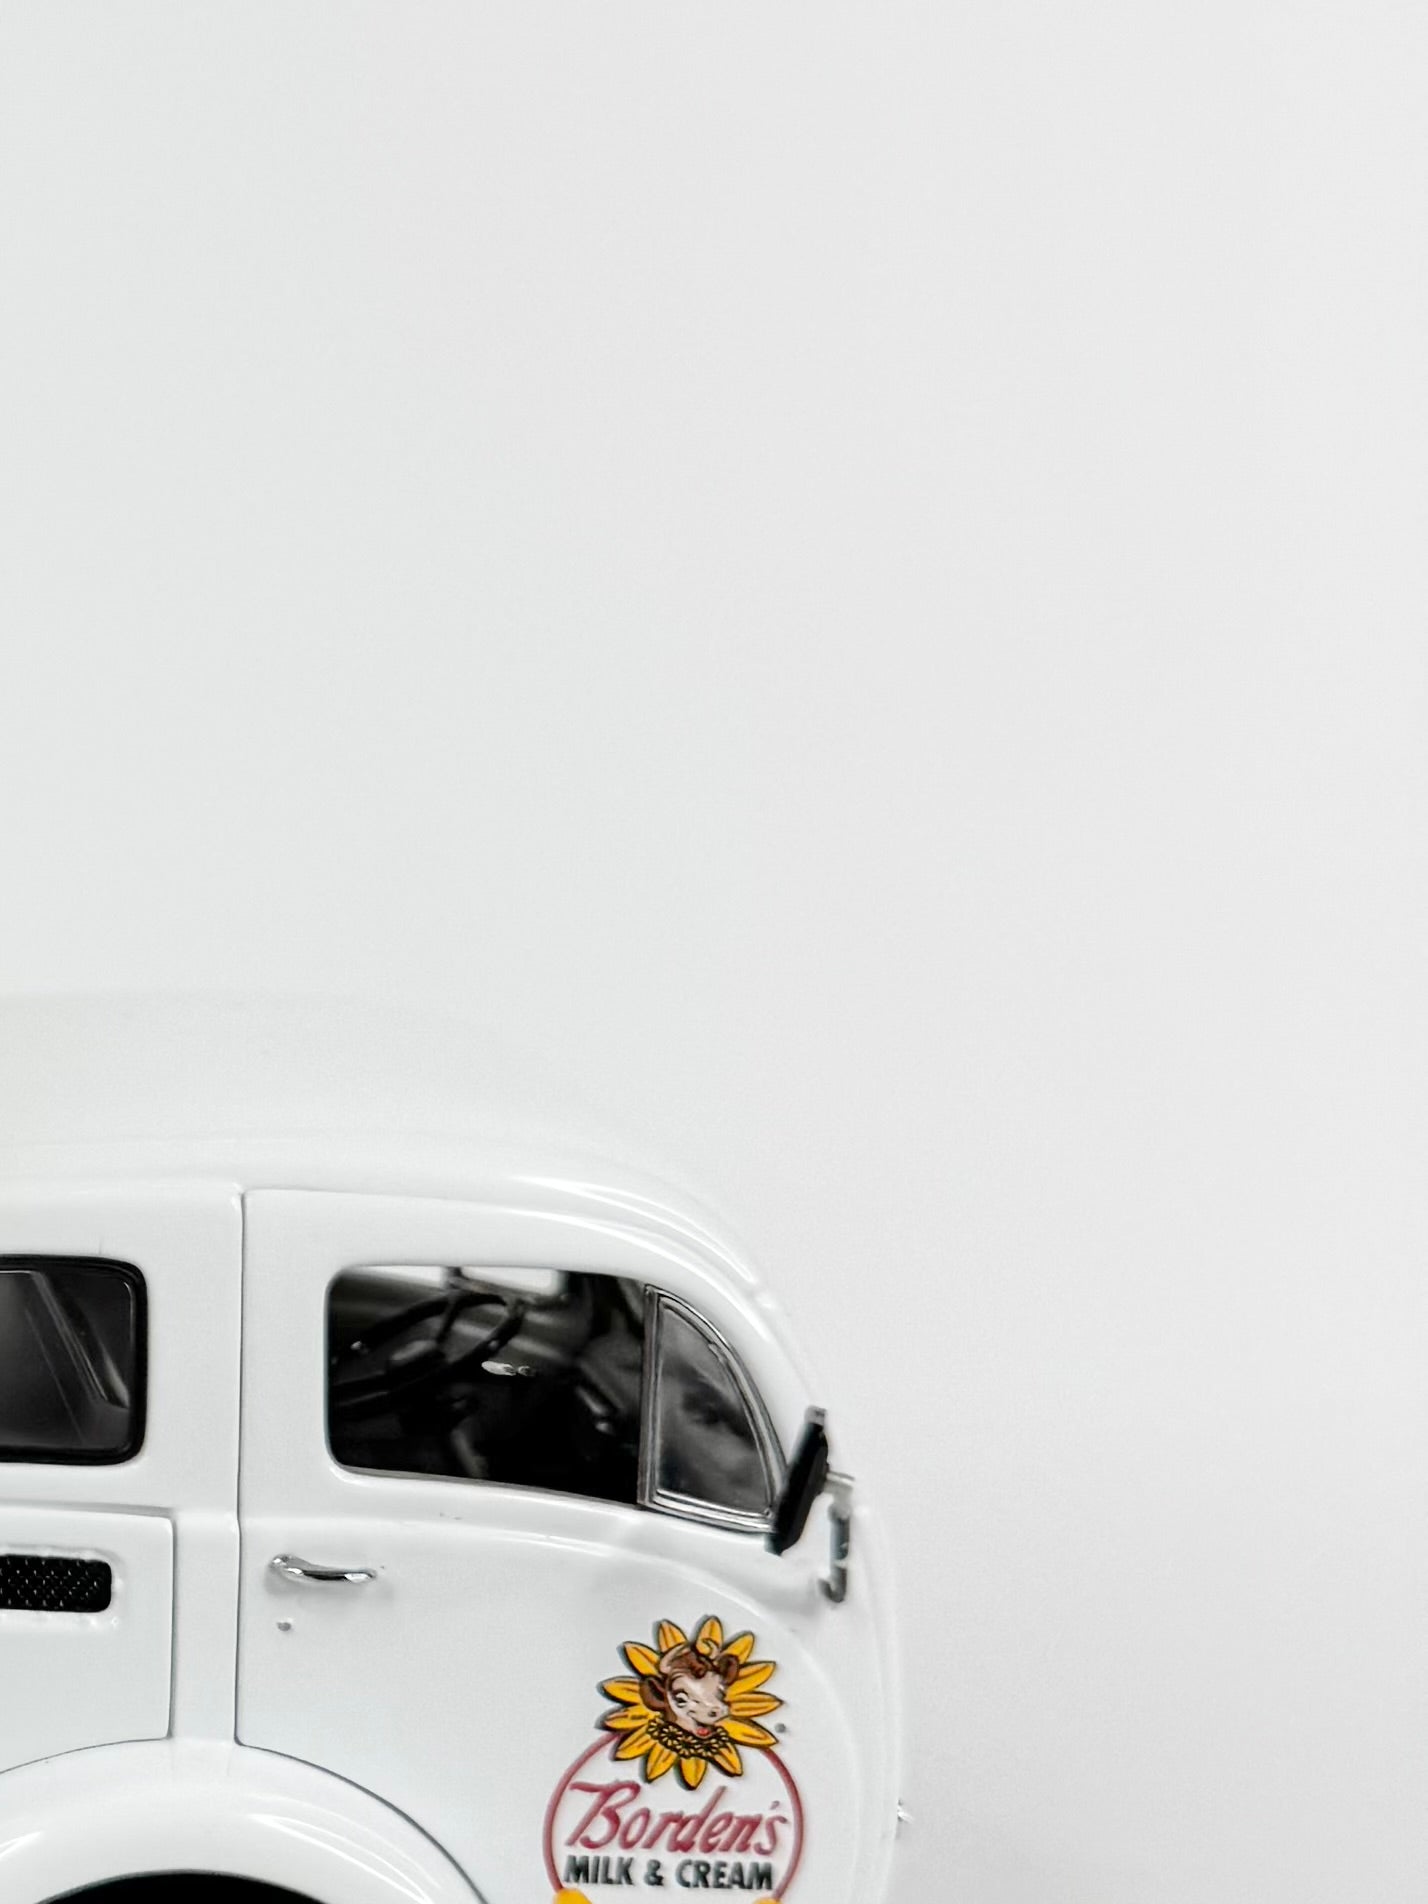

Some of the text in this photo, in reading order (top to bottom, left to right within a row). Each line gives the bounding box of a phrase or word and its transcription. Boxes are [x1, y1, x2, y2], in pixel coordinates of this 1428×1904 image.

[564, 1780, 789, 1856] Borden's
[563, 1855, 774, 1891] MILK & CREAM
